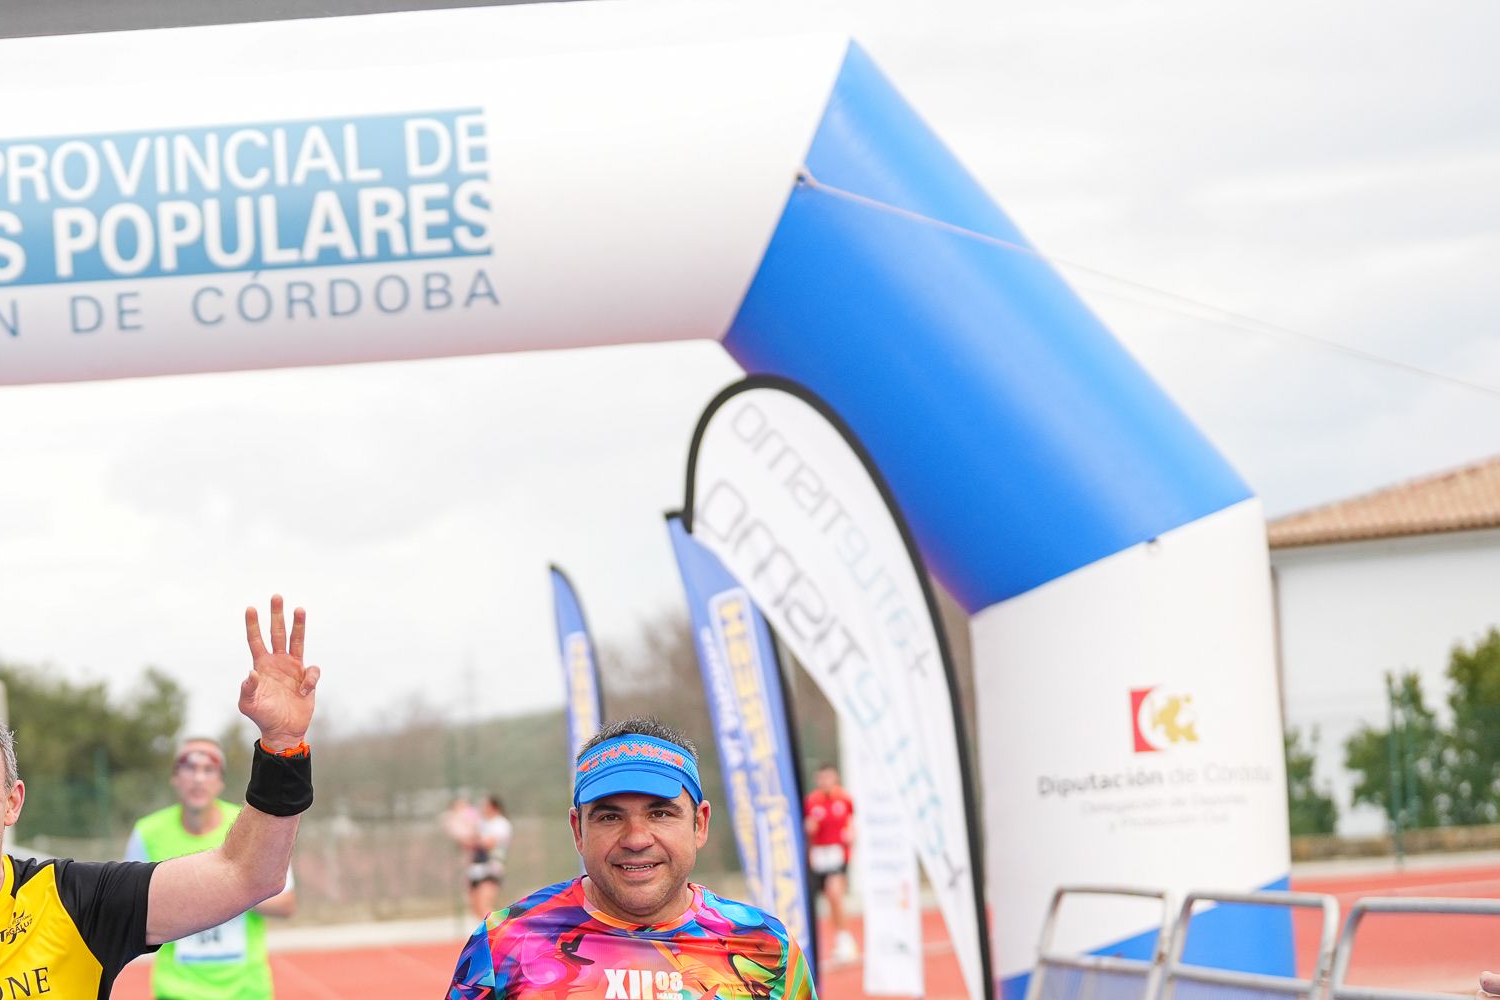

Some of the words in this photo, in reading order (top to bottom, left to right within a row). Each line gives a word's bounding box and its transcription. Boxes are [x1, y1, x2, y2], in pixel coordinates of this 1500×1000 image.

[404, 112, 487, 176] DE
[54, 180, 494, 278] POPULARES
[71, 293, 144, 336] DE
[191, 267, 501, 327] CÓRDOBA
[1037, 767, 1165, 798] Diputación
[604, 968, 654, 1000] XII
[655, 970, 684, 991] 08
